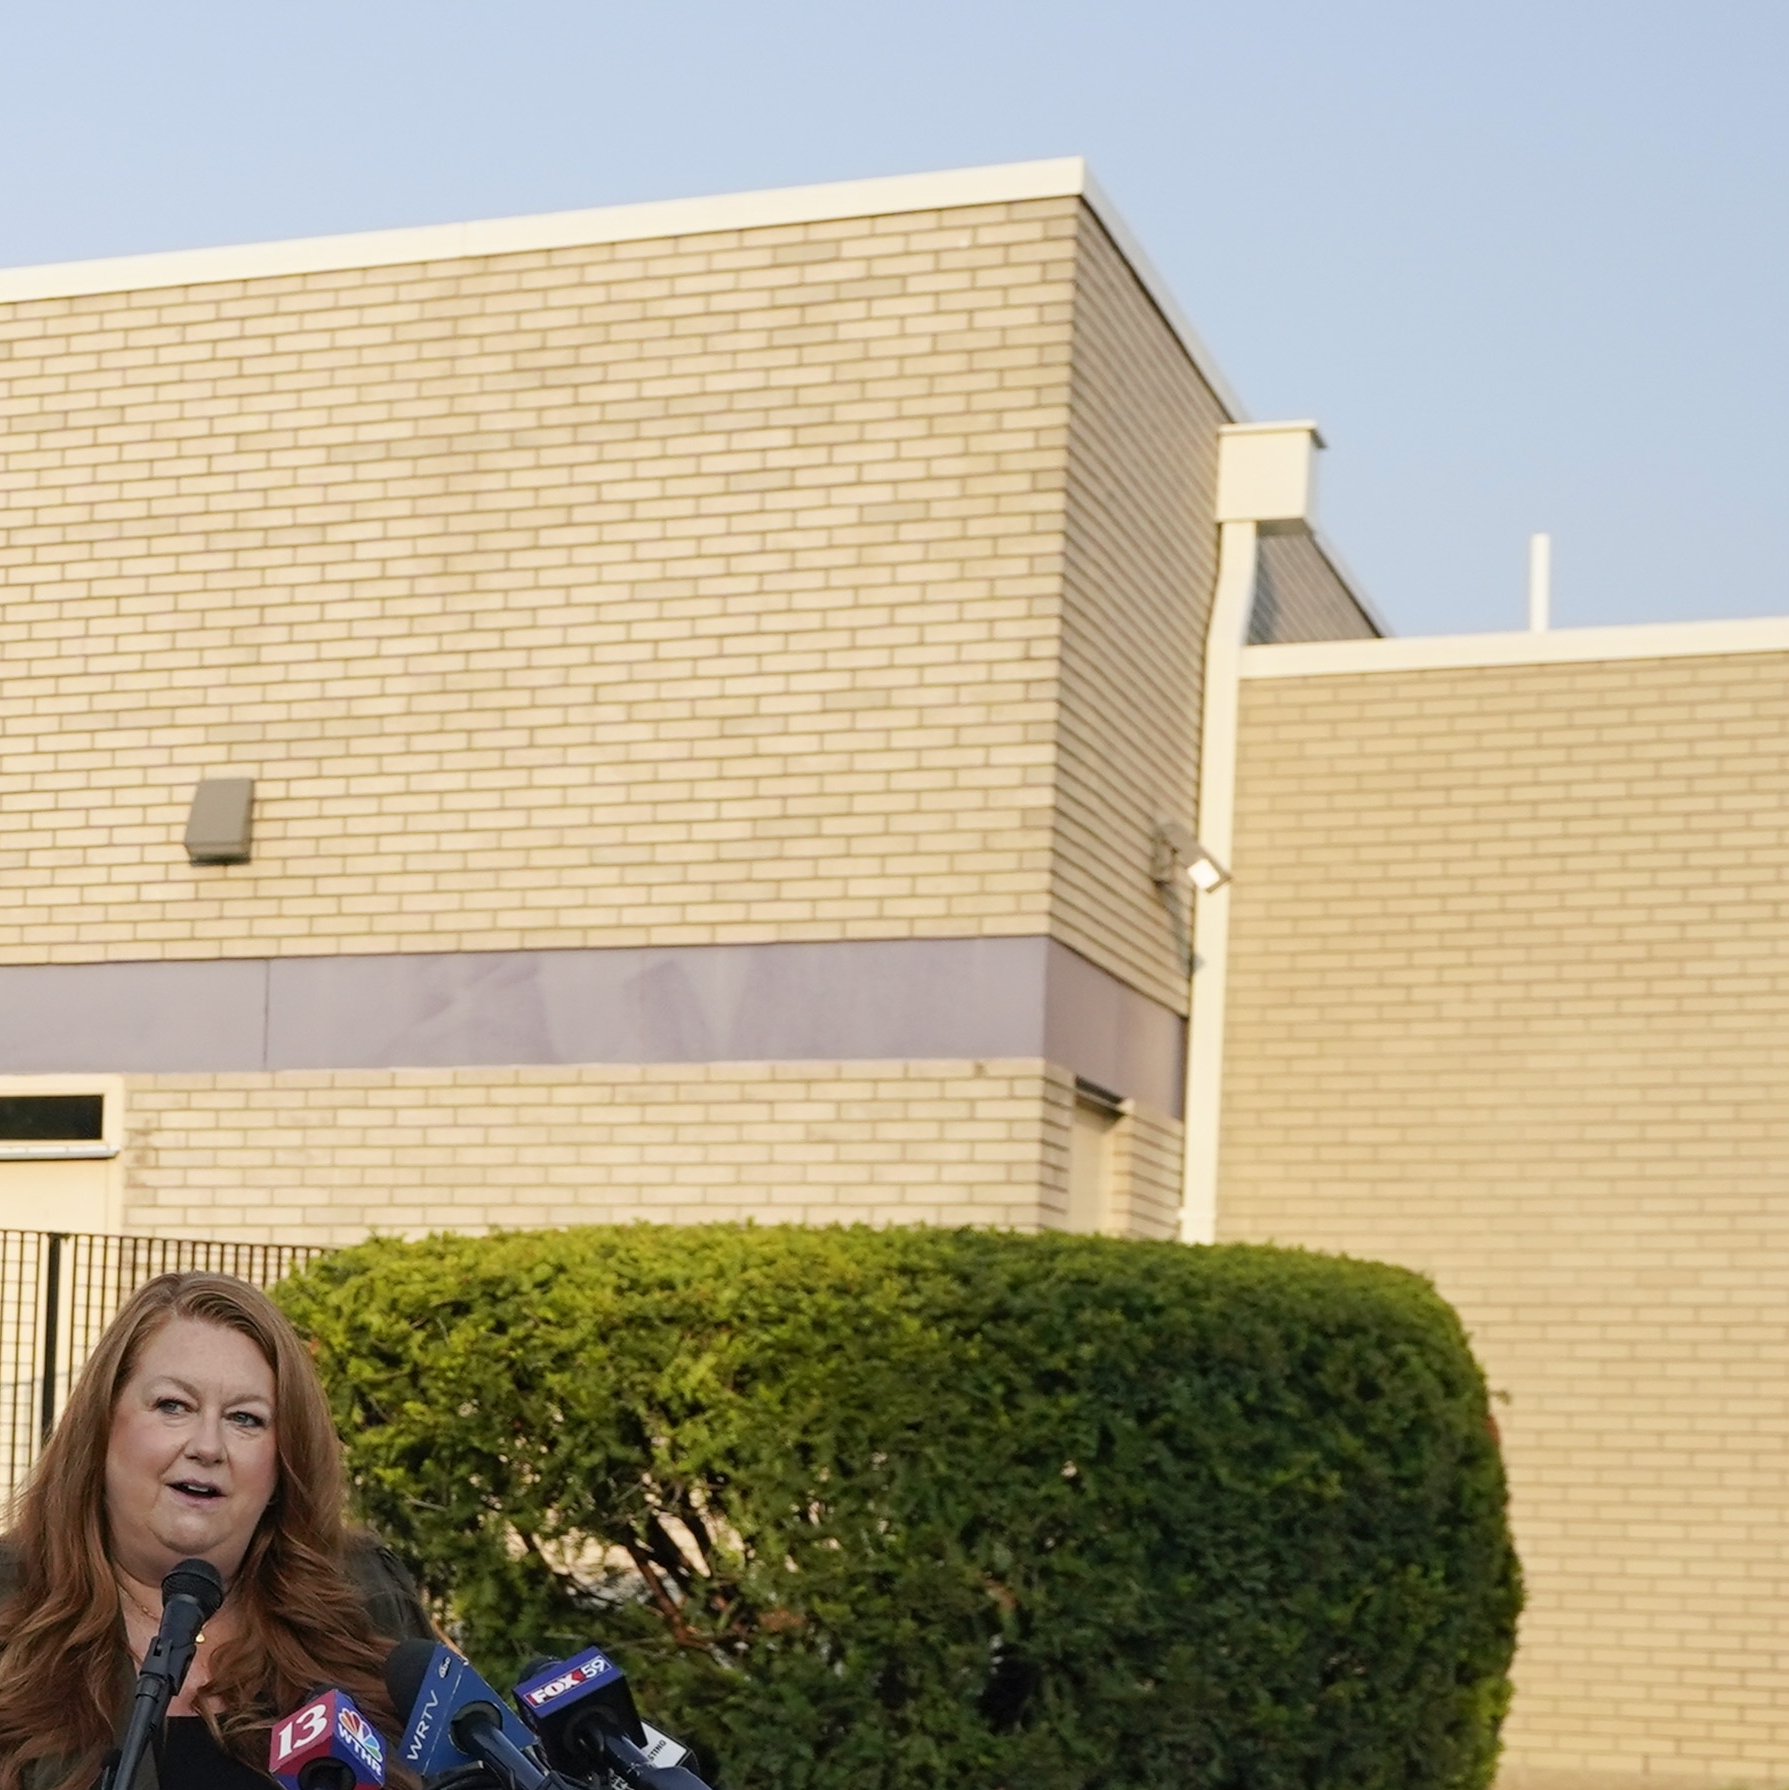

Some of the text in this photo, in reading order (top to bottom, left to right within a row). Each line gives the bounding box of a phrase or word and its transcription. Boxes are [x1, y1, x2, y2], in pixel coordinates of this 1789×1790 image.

[530, 1659, 605, 1704] FOX 59
[278, 1704, 328, 1760] 13
[338, 1722, 382, 1776] WTHR
[407, 1689, 439, 1760] WRTV
